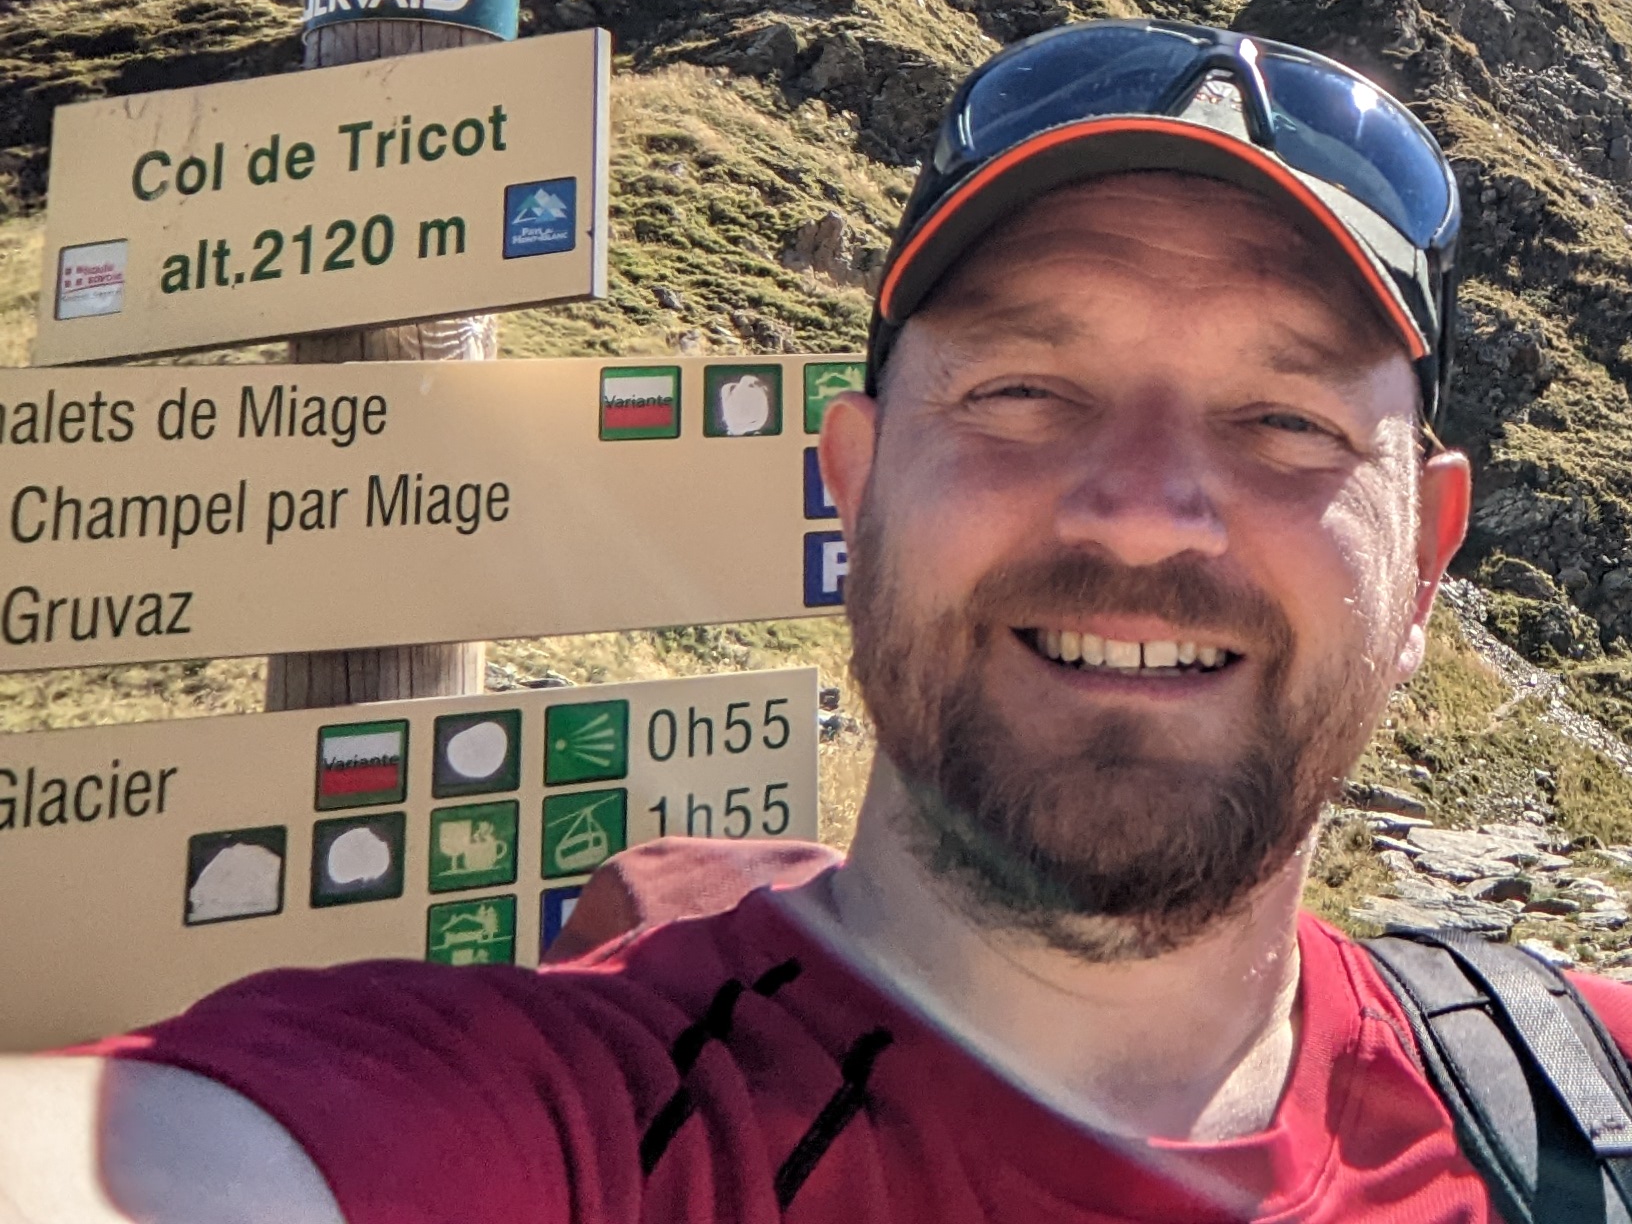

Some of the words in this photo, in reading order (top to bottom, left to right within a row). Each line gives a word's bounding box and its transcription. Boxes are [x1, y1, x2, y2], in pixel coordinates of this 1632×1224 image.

[131, 148, 224, 202] Col
[247, 133, 316, 186] de
[338, 104, 508, 172] Tricot
[418, 216, 467, 259] m
[0, 388, 136, 445] alets
[157, 387, 217, 441] de
[238, 384, 388, 448] Miage
[604, 394, 674, 408] Variante
[11, 479, 248, 550] Champel
[265, 487, 349, 545] par
[366, 472, 510, 536] Miage
[1, 585, 194, 645] Gruvaz
[648, 698, 791, 762] 0h55
[323, 753, 402, 771] Variante
[648, 782, 791, 839] 1h55
